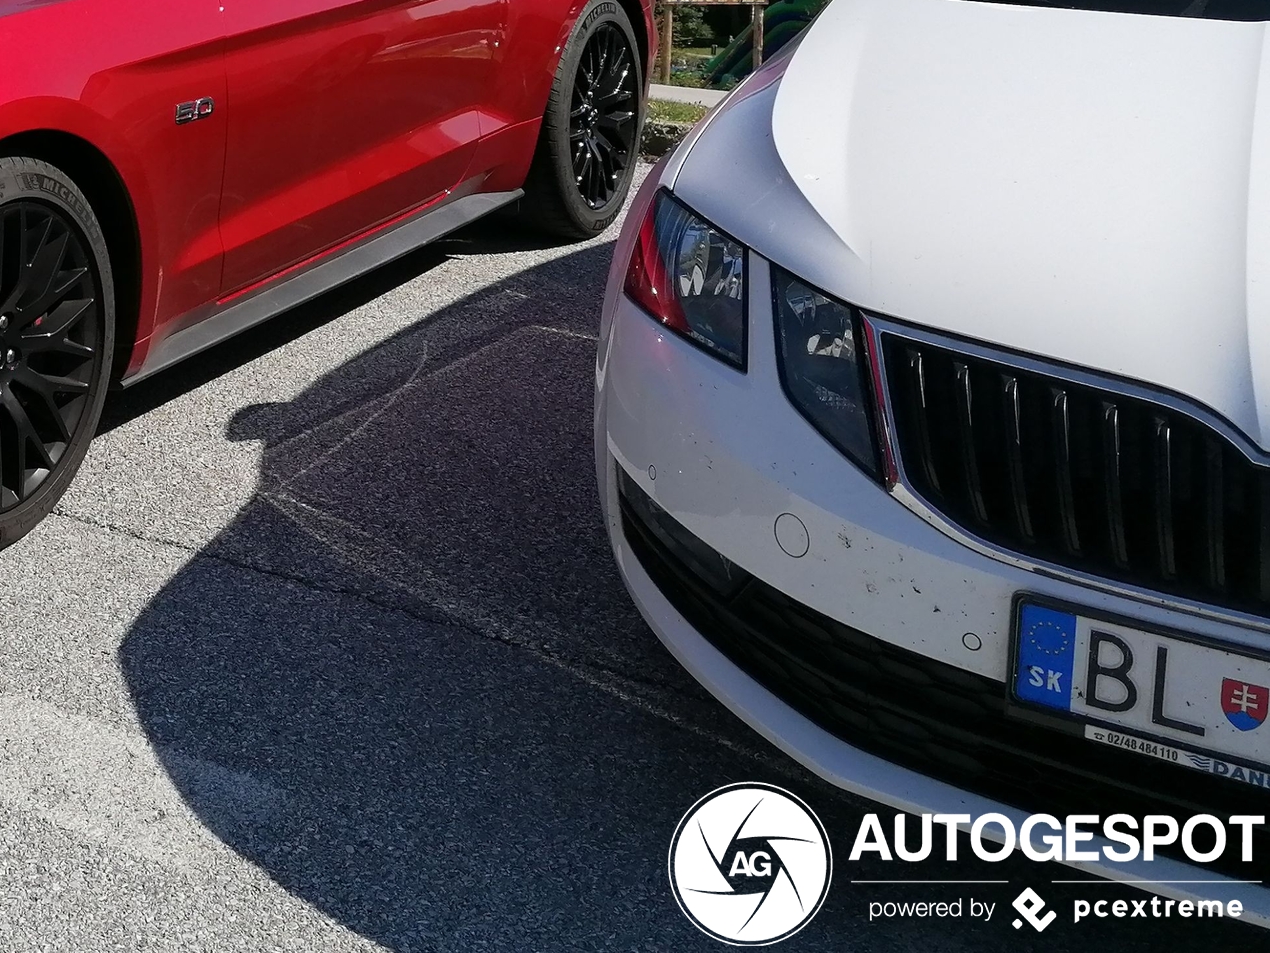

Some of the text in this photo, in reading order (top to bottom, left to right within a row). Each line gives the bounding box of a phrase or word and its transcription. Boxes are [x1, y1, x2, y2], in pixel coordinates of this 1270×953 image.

[175, 96, 215, 125] 5.0
[1028, 665, 1063, 693] SK
[1085, 629, 1205, 737] BL
[1107, 732, 1179, 762] 02/48 484 110
[1213, 759, 1270, 789] DAN
